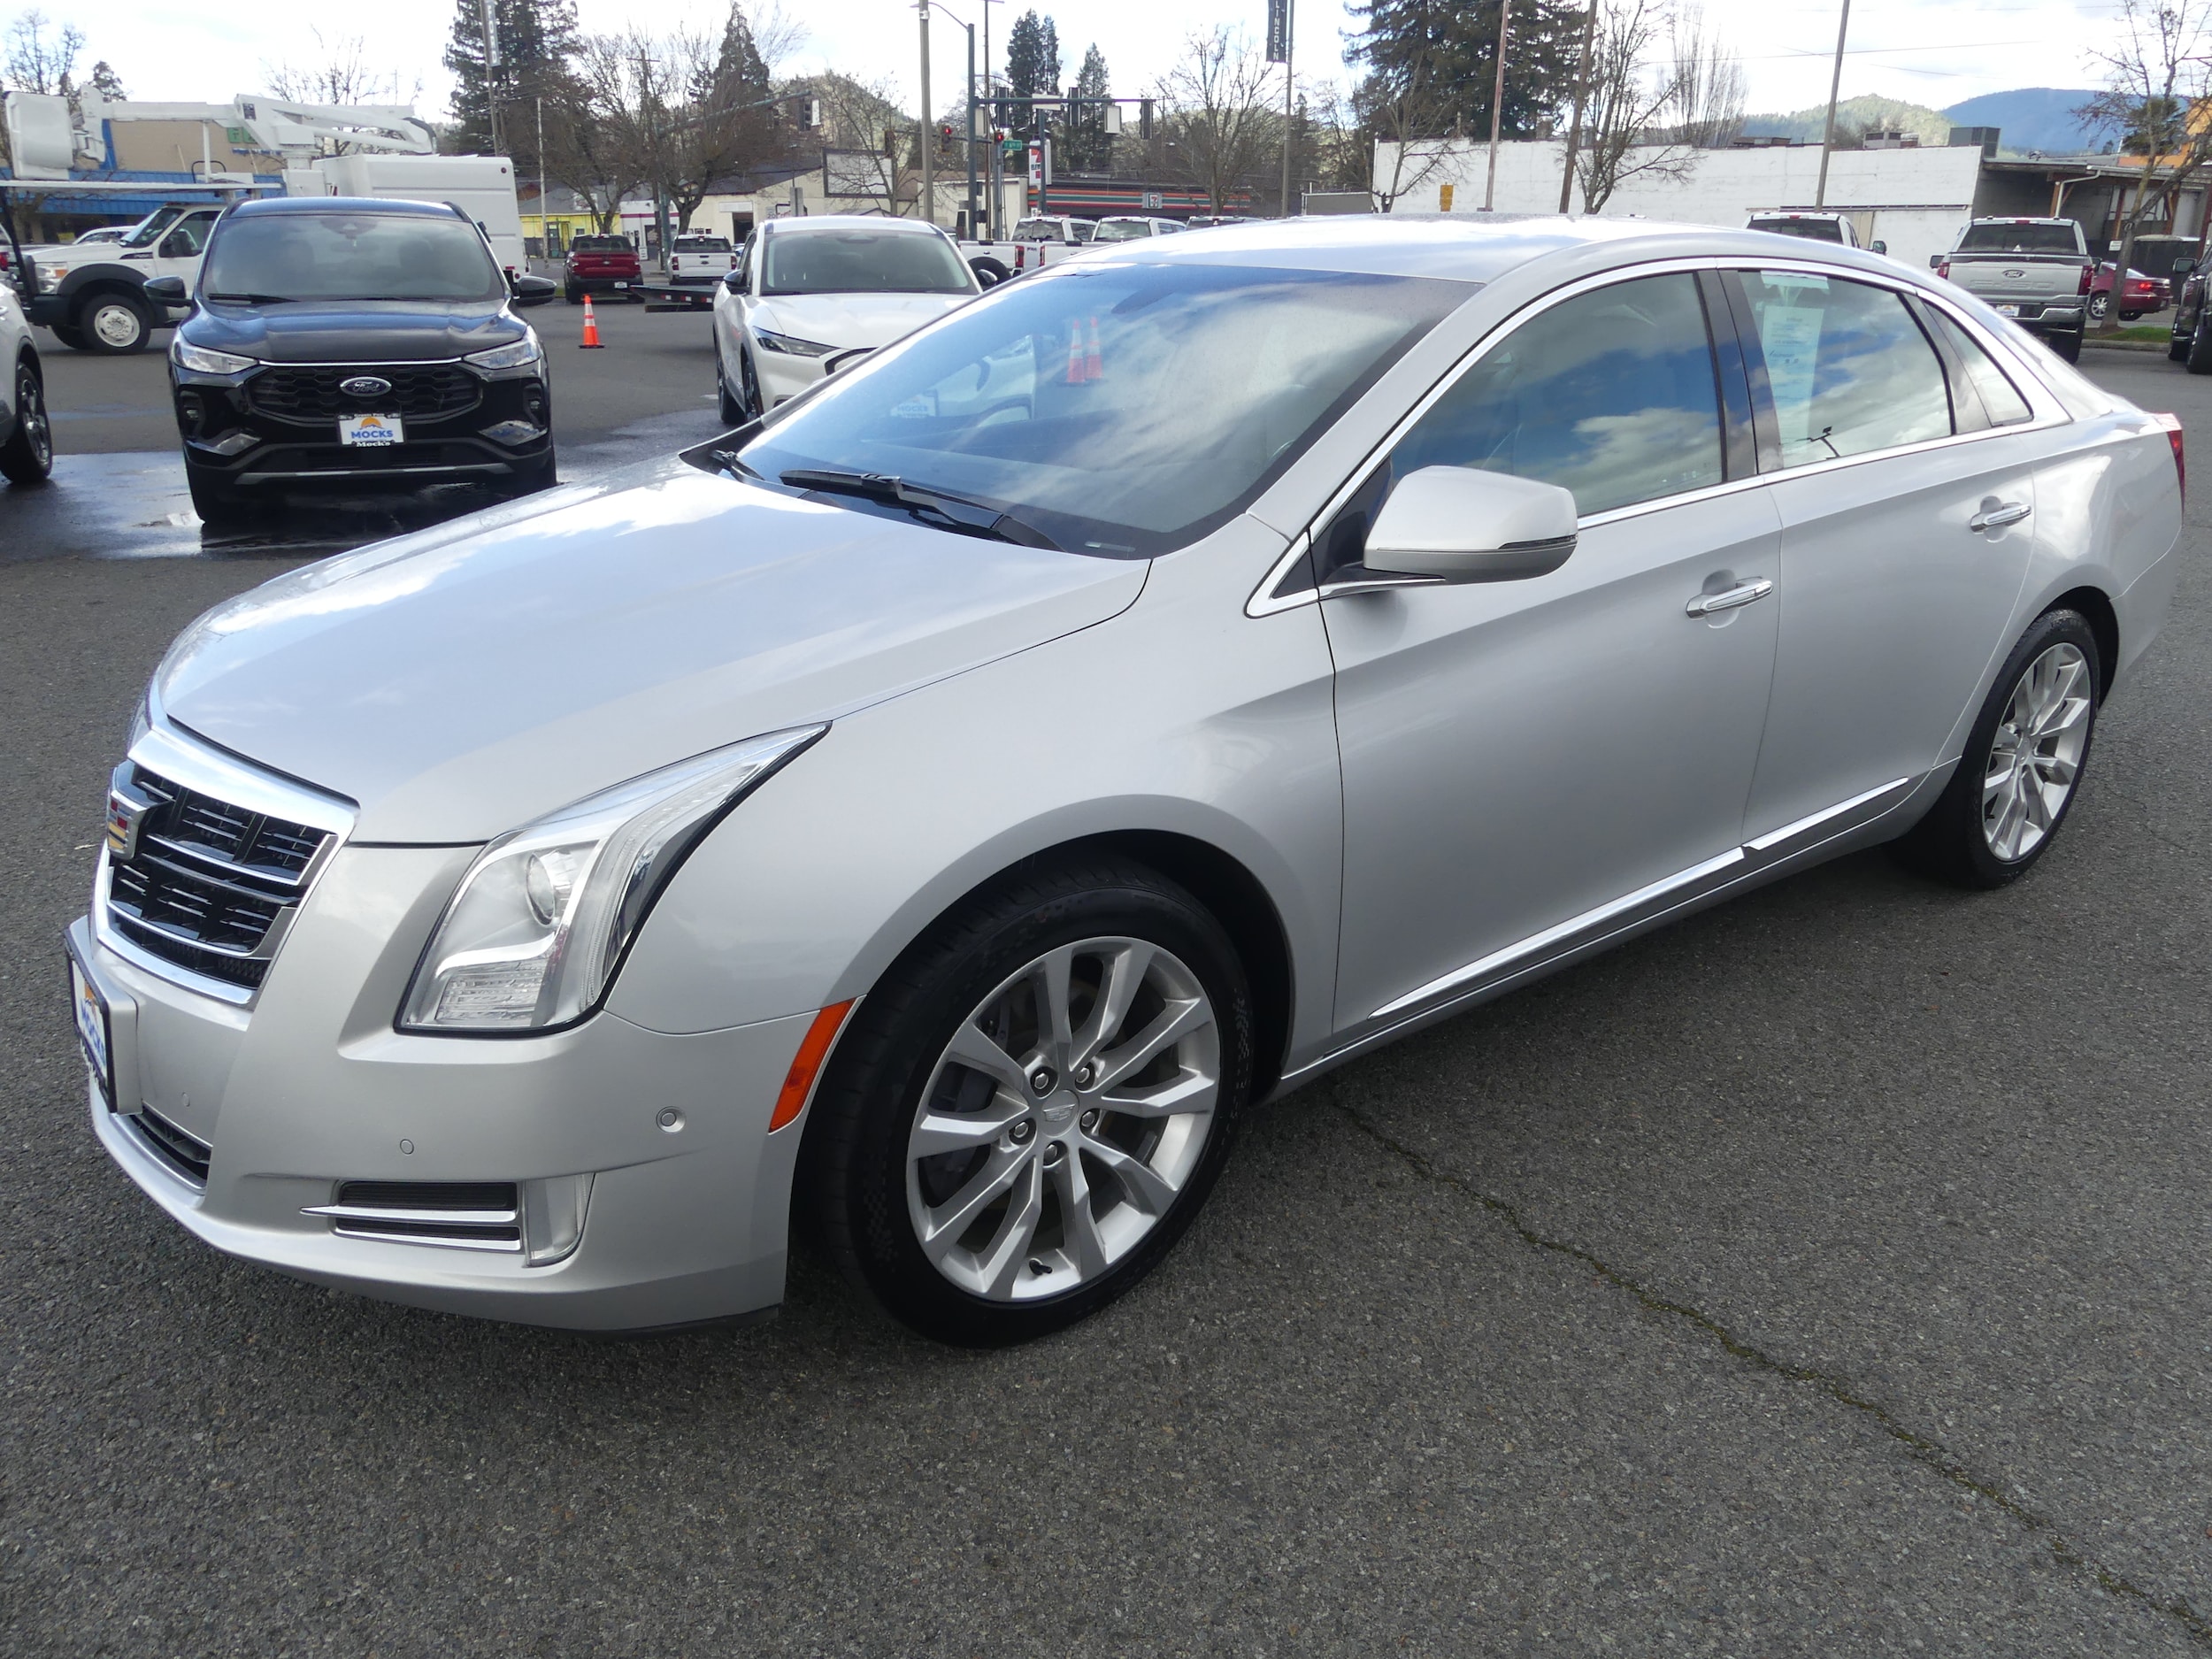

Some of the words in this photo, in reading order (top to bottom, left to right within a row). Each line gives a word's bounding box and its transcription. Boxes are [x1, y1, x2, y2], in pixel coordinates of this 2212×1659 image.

[488, 4, 497, 64] FORD
[354, 380, 380, 392] Ford
[350, 430, 394, 439] MOCKS
